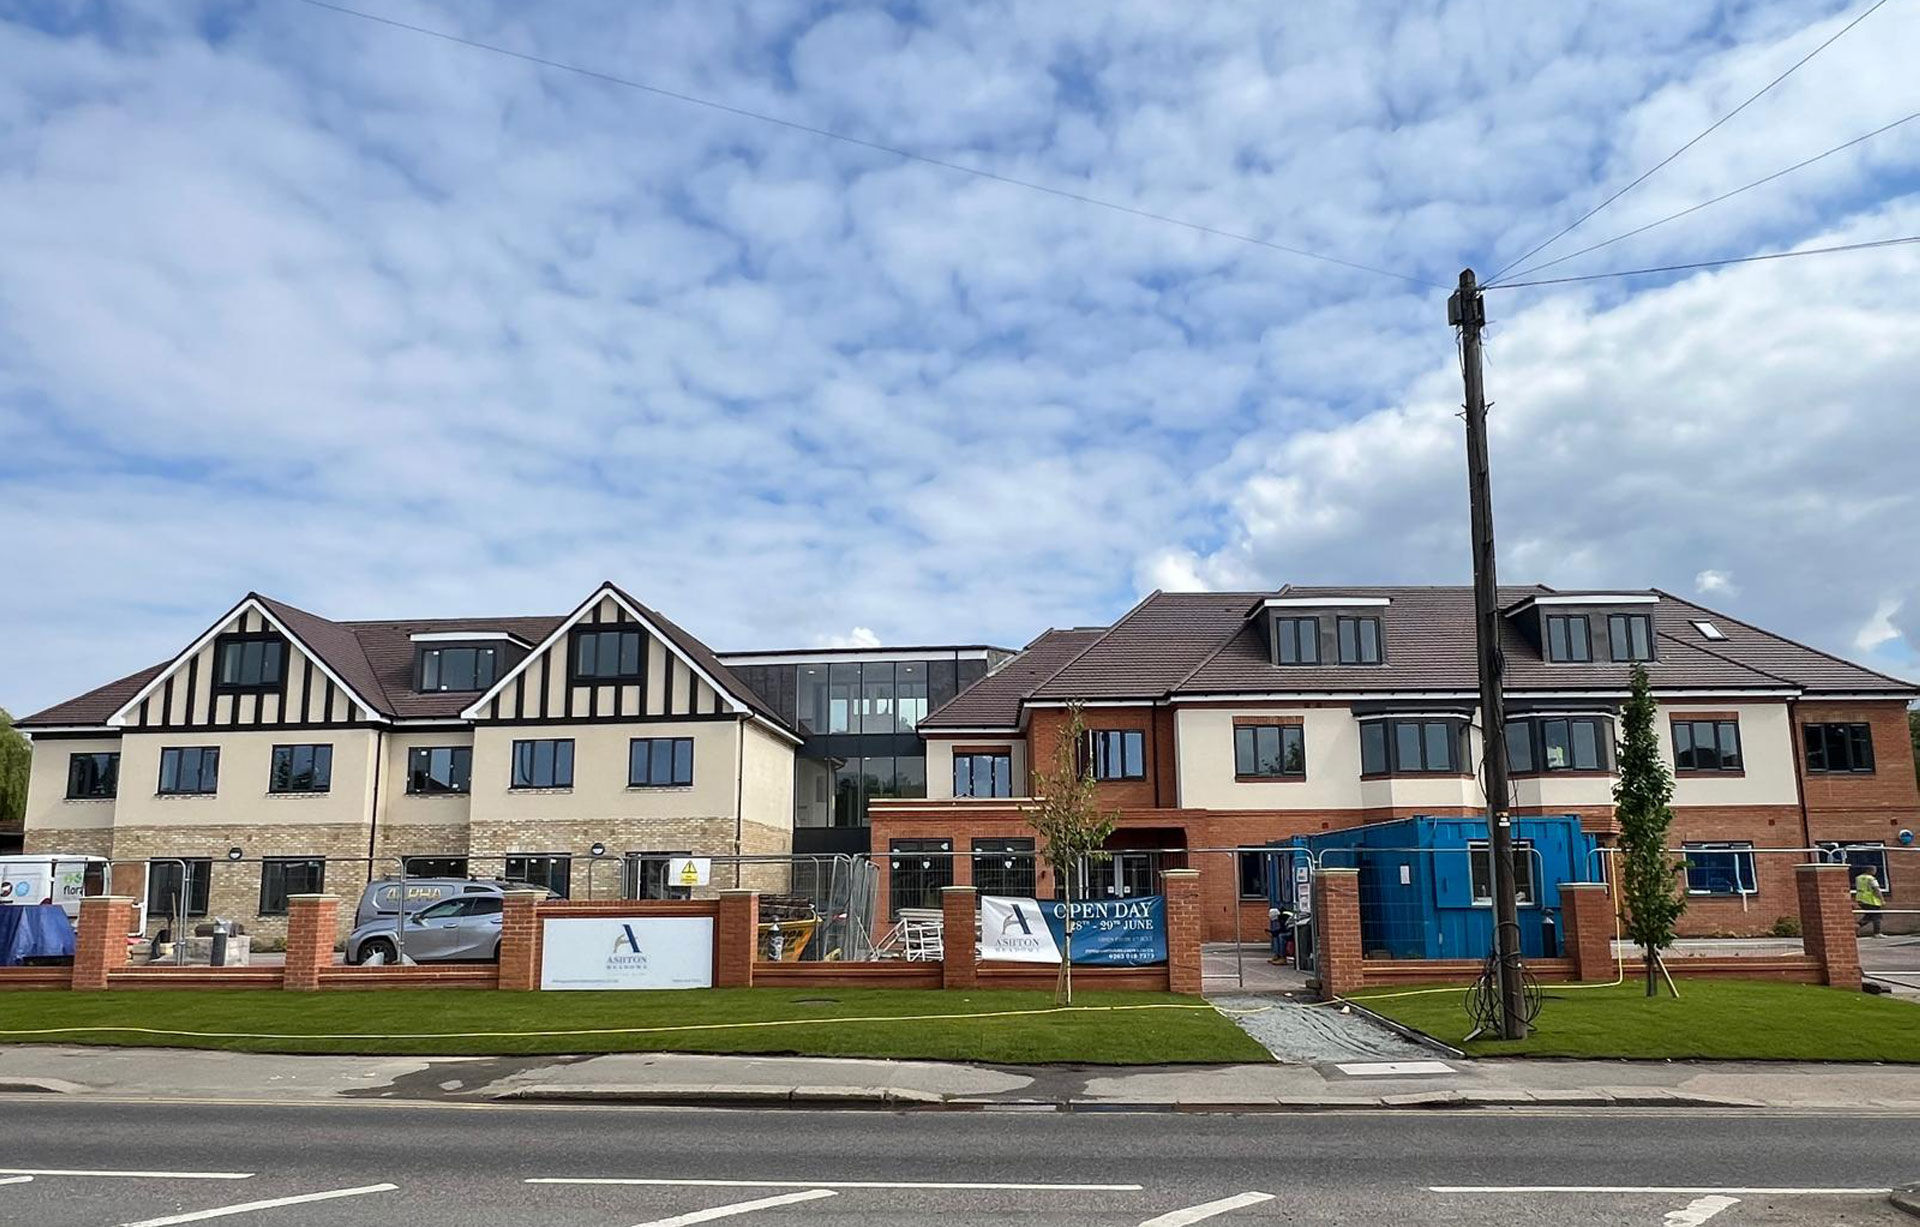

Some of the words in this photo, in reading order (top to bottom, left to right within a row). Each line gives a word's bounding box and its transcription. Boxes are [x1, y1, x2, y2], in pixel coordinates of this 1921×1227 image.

[1053, 903, 1108, 918] OPEN
[1115, 902, 1152, 918] DAY
[1123, 919, 1154, 930] JUNE
[995, 938, 1039, 946] ASHTON
